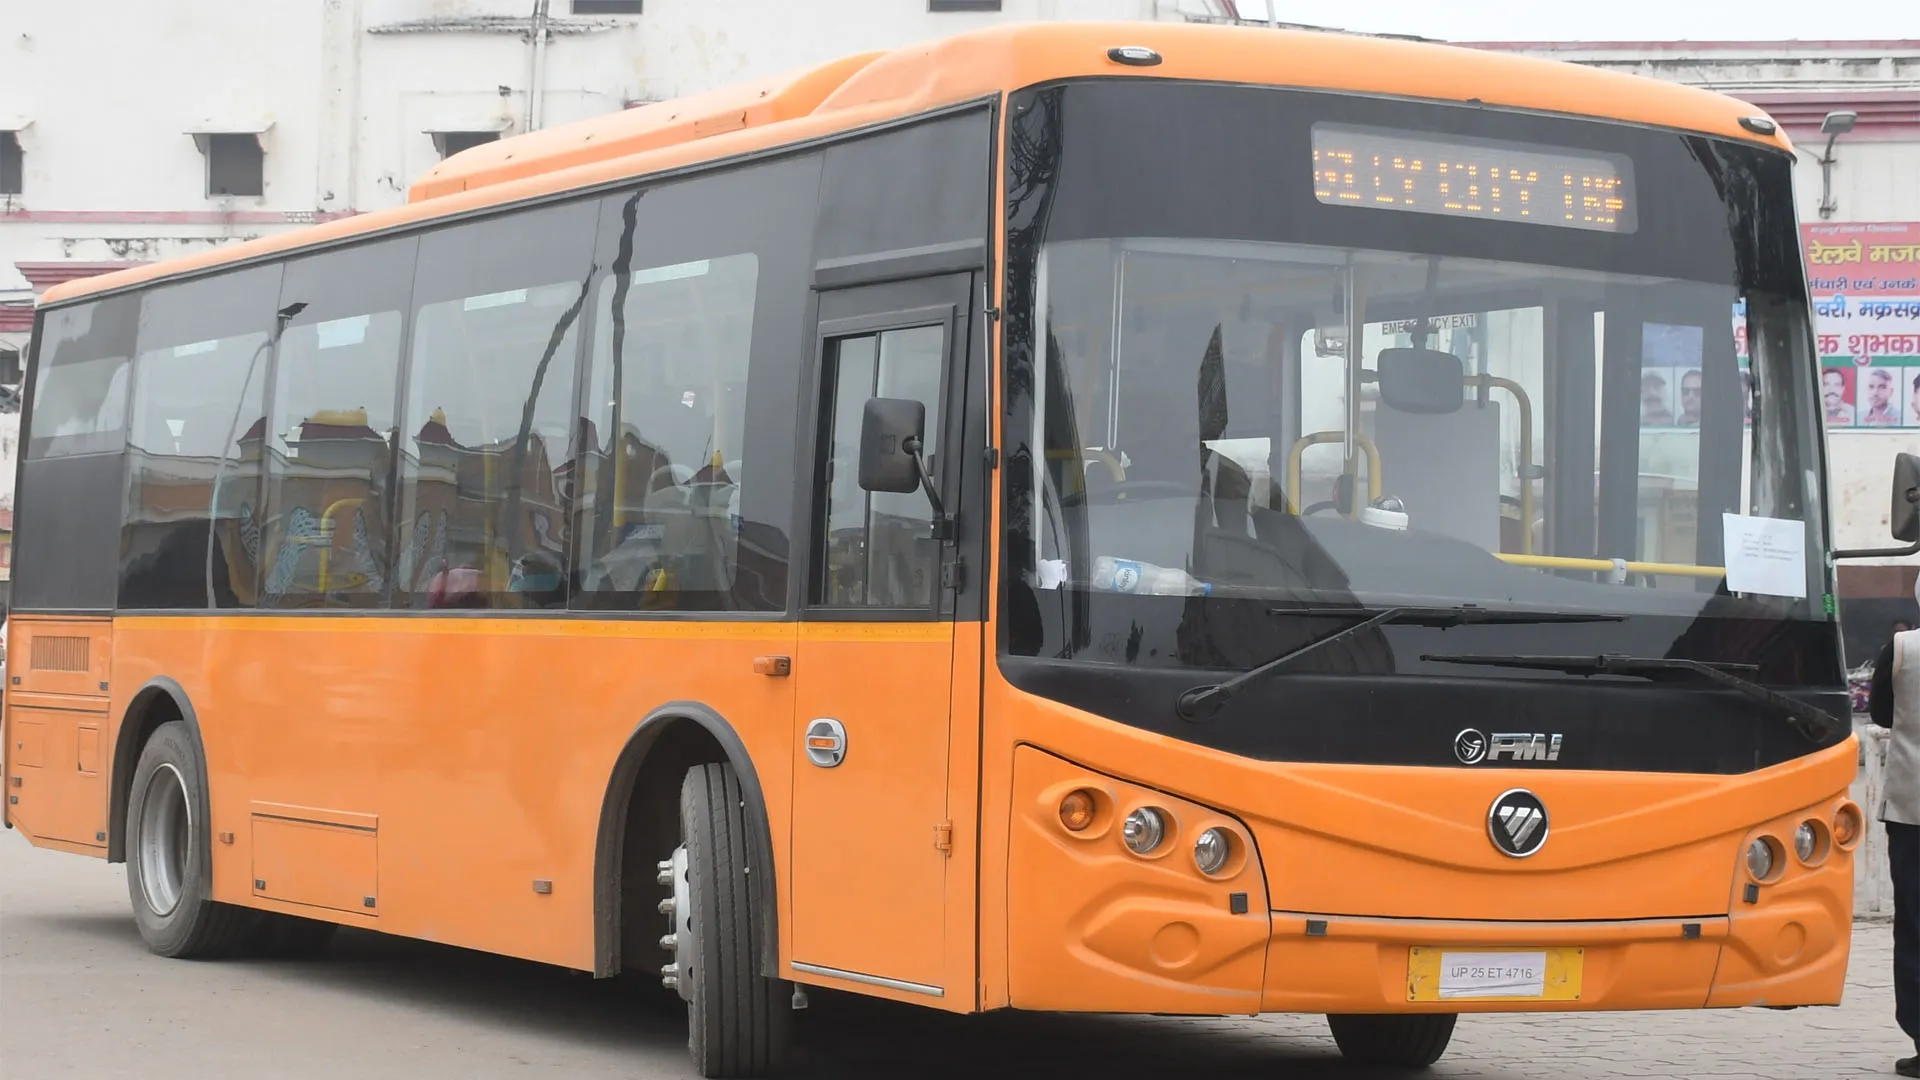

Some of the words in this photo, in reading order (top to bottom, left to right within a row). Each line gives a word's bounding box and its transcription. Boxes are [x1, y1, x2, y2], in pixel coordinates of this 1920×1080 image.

[1440, 163, 1537, 216] CITY
[1808, 238, 1863, 265] रेलवे
[1452, 314, 1476, 329] EXIT
[1451, 967, 1468, 979] UP
[1471, 967, 1485, 979] 25
[1487, 967, 1503, 979] ET
[1505, 967, 1533, 980] 4716
